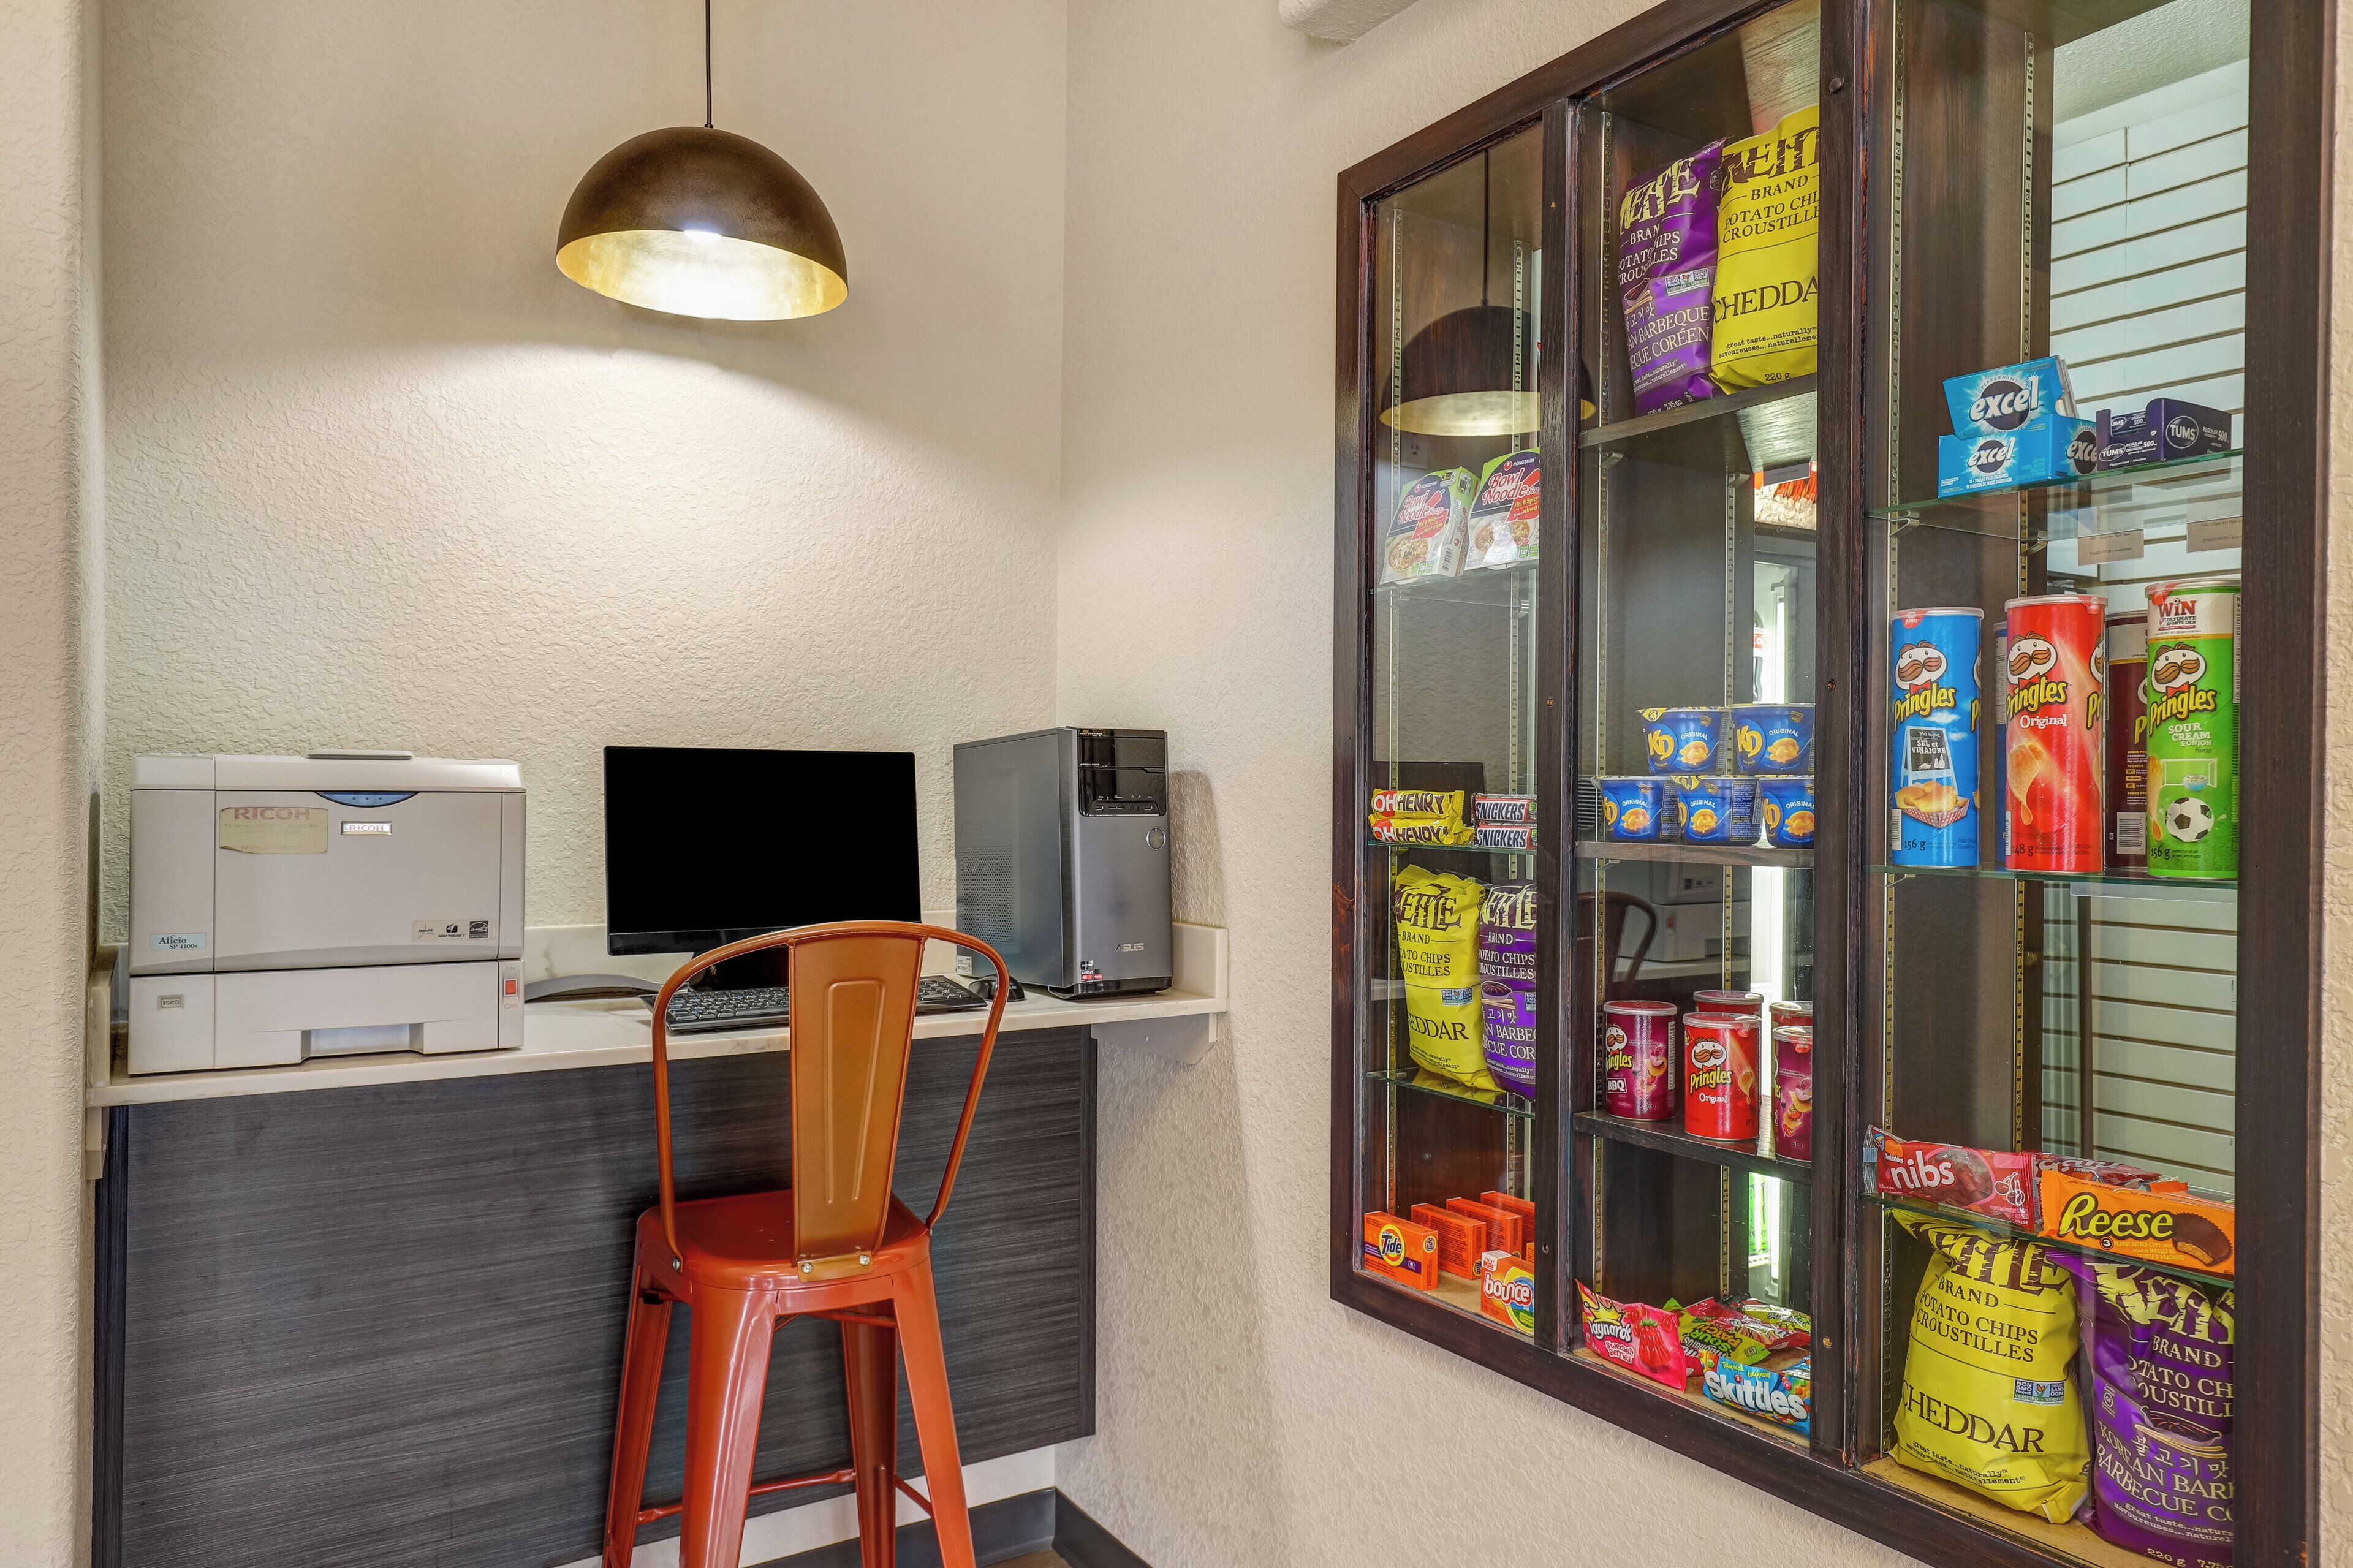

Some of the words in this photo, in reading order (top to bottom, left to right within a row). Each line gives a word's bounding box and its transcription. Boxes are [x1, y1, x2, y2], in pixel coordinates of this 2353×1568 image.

[1750, 175, 1808, 201] BRAND
[1724, 203, 1785, 231] POTATO
[1639, 306, 1710, 344] BARBEQUE
[1652, 326, 1709, 357] CORÉEN
[1726, 339, 1745, 350] great
[1764, 372, 1782, 382] 220
[1969, 375, 2039, 422] excel
[2170, 424, 2197, 441] TUMS
[2202, 426, 2218, 436] REGULAR
[2217, 431, 2228, 442] 500
[1513, 458, 1535, 466] NONGSHIM
[1967, 437, 2016, 468] excel
[2102, 447, 2124, 458] TUMS
[1488, 468, 1525, 489] Bowl
[1403, 490, 1430, 510] Bowl
[1482, 483, 1528, 506] Noodle
[1526, 496, 1538, 504] Spicy
[1397, 502, 1430, 526] Noodle
[1894, 683, 1956, 733] Pringles
[2150, 685, 2216, 735] Pringles
[2020, 713, 2068, 729] Original
[2169, 722, 2202, 734] SOUR
[1681, 732, 1708, 740] ORIGINAL
[1737, 725, 1764, 757] KD
[1769, 728, 1799, 737] ORIGINAL
[2172, 731, 2211, 741] CREAM
[1648, 729, 1675, 760] KD
[1373, 793, 1396, 812] OH
[1396, 792, 1445, 815] HENRY
[1476, 801, 1526, 821] SNICKERS
[1622, 799, 1649, 808] ORIGINAL
[1690, 798, 1716, 808] ORIGINAL
[234, 808, 310, 820] RICOH
[1764, 798, 1781, 830] KD
[1373, 826, 1395, 842] OH
[1477, 829, 1528, 848] SNICKERS
[1904, 839, 1917, 850] 156
[1920, 841, 1927, 851] g
[2027, 845, 2034, 857] g
[2151, 845, 2162, 860] 156
[2164, 849, 2171, 860] g
[158, 934, 187, 944] Aficio
[1402, 931, 1430, 944] BRAND
[1488, 931, 1514, 945] BRAND
[1113, 942, 1145, 953] ASUS
[1479, 948, 1499, 963] POTATO
[1502, 952, 1536, 966] CHIPS
[1420, 952, 1451, 964] CHIPS
[1608, 1080, 1625, 1092] BBQ
[1690, 1067, 1733, 1095] Pringles
[1699, 1093, 1728, 1104] Original
[1884, 1152, 1904, 1164] Twizzlers
[1890, 1150, 1956, 1189] nibs
[2059, 1193, 2173, 1238] Reese
[1381, 1234, 1403, 1256] Tide
[1485, 1273, 1530, 1304] bounce
[1937, 1276, 1999, 1308] BRAND
[1920, 1292, 1969, 1327] POTATO
[1976, 1317, 2038, 1345] CHIPS
[1689, 1329, 1732, 1352] SOUR
[1696, 1324, 1743, 1348] PATCH
[1915, 1309, 2034, 1363] CROUSTILLES
[1605, 1341, 1635, 1357] Swedish
[1609, 1348, 1633, 1364] Berries
[2152, 1335, 2222, 1368] BRAND
[1721, 1360, 1745, 1372] Tropical
[1703, 1371, 1808, 1421] Skittles
[1902, 1379, 2044, 1453] CHEDDAR
[1913, 1441, 1930, 1455] great
[2098, 1420, 2164, 1487] KOREAN
[2097, 1443, 2199, 1517] BARBECUE
[2124, 1502, 2152, 1520] great
[2146, 1548, 2172, 1562] 220
[2177, 1559, 2186, 1567] g
